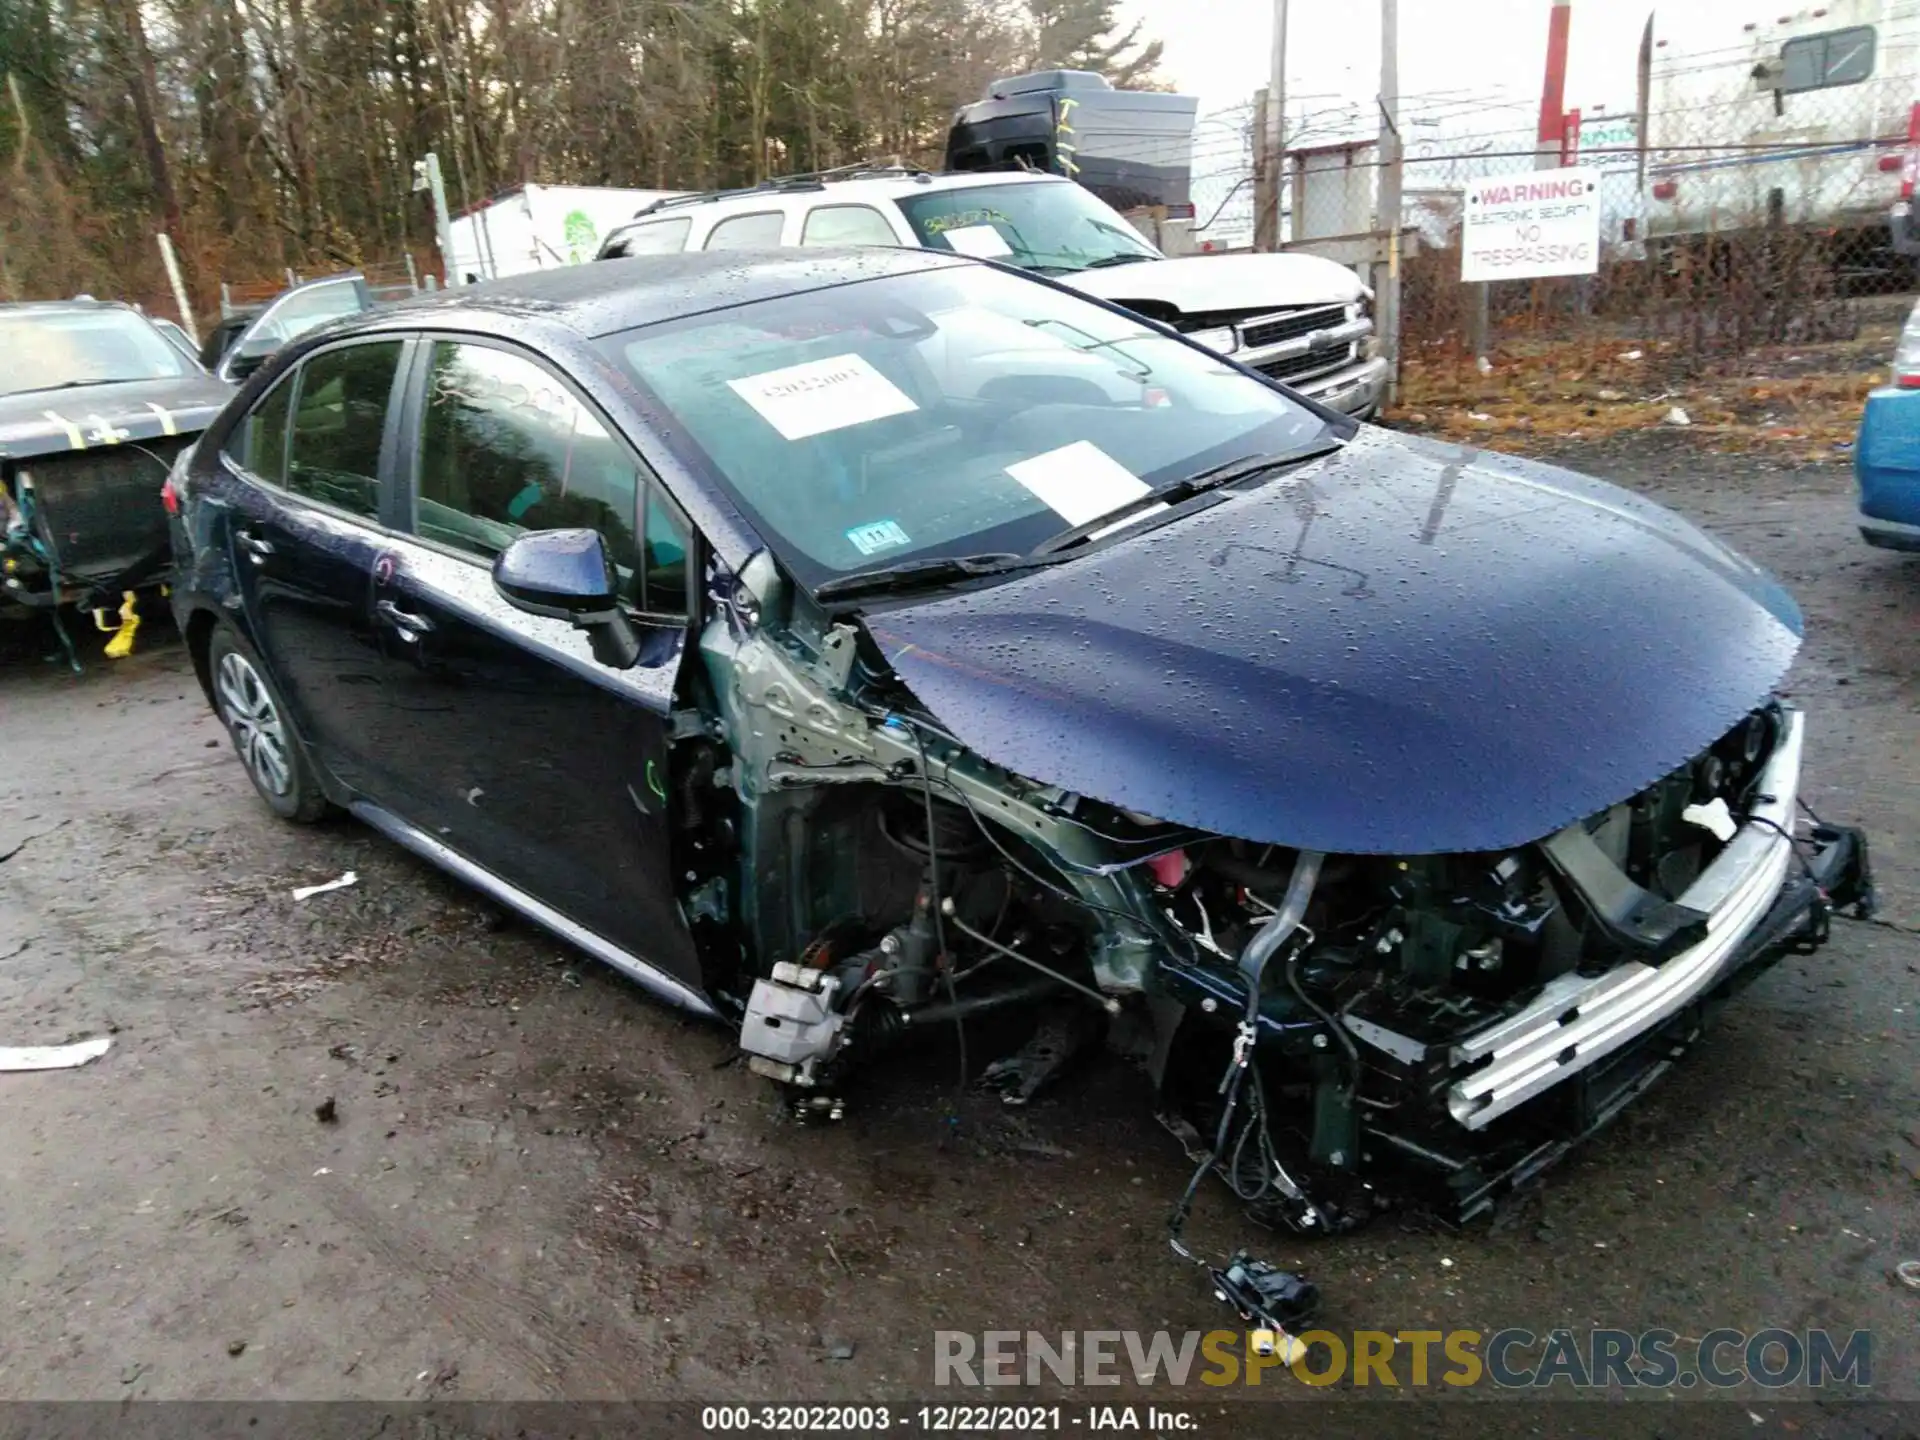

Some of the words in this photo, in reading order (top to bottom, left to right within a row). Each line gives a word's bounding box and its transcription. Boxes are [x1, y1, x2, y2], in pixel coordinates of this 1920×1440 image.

[1480, 179, 1583, 205] WARNING
[1516, 225, 1541, 242] NO
[1472, 242, 1589, 267] TRESPASSING
